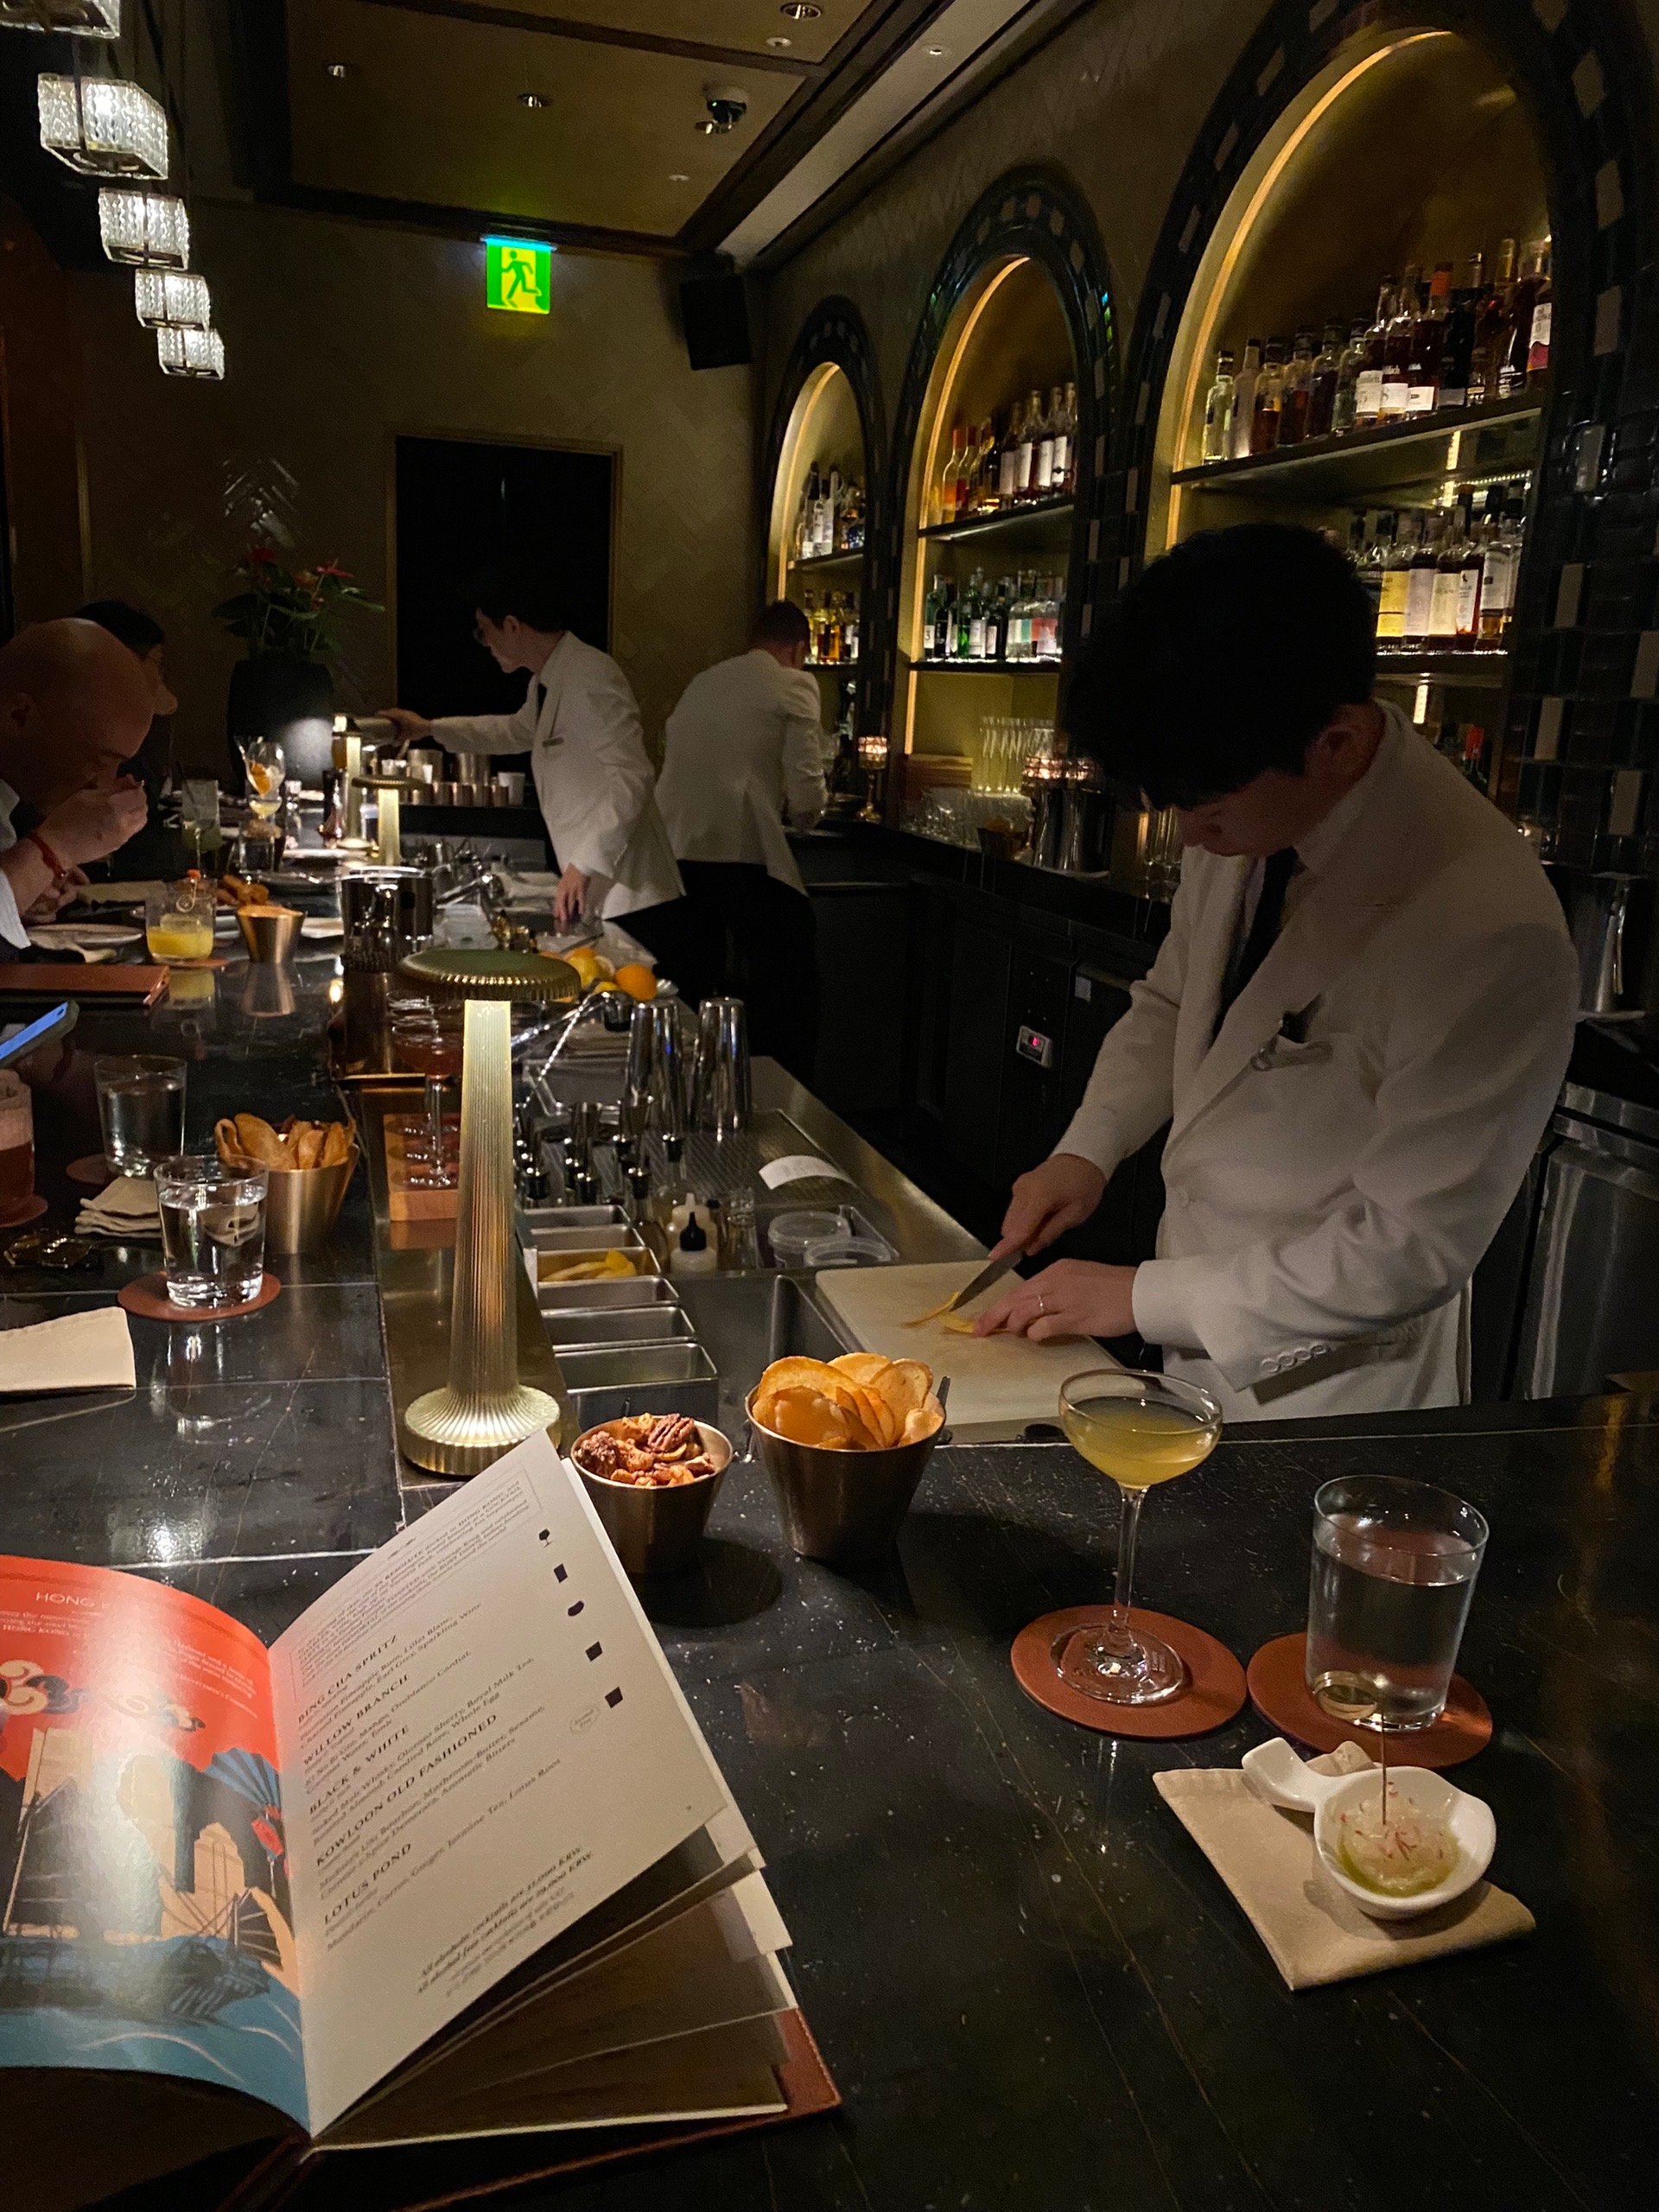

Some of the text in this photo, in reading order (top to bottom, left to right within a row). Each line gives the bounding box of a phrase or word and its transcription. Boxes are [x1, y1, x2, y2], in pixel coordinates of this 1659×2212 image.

[298, 1697, 325, 1723] BING
[327, 1673, 352, 1694] CHA
[356, 1635, 396, 1669] SPRITZ
[377, 1667, 394, 1683] Earl
[417, 1620, 458, 1651] Sparkling
[459, 1604, 481, 1619] Wine
[304, 1719, 352, 1764] WILLOW
[357, 1675, 407, 1719] BRANCH
[340, 1670, 378, 1705] Pineapple
[451, 1706, 480, 1728] Whole
[483, 1692, 499, 1707] Egg
[467, 1686, 492, 1708] Royal
[493, 1671, 514, 1688] Milk
[310, 1777, 348, 1814] BLACK
[353, 1766, 361, 1776] &
[365, 1727, 405, 1762] WHITE
[317, 1803, 383, 1866] KOWLOON
[387, 1777, 415, 1802] OLD
[419, 1715, 496, 1777] FASHIONED
[537, 1758, 561, 1777] Root
[325, 1882, 368, 1924] LOTUS
[372, 1844, 410, 1880] POND
